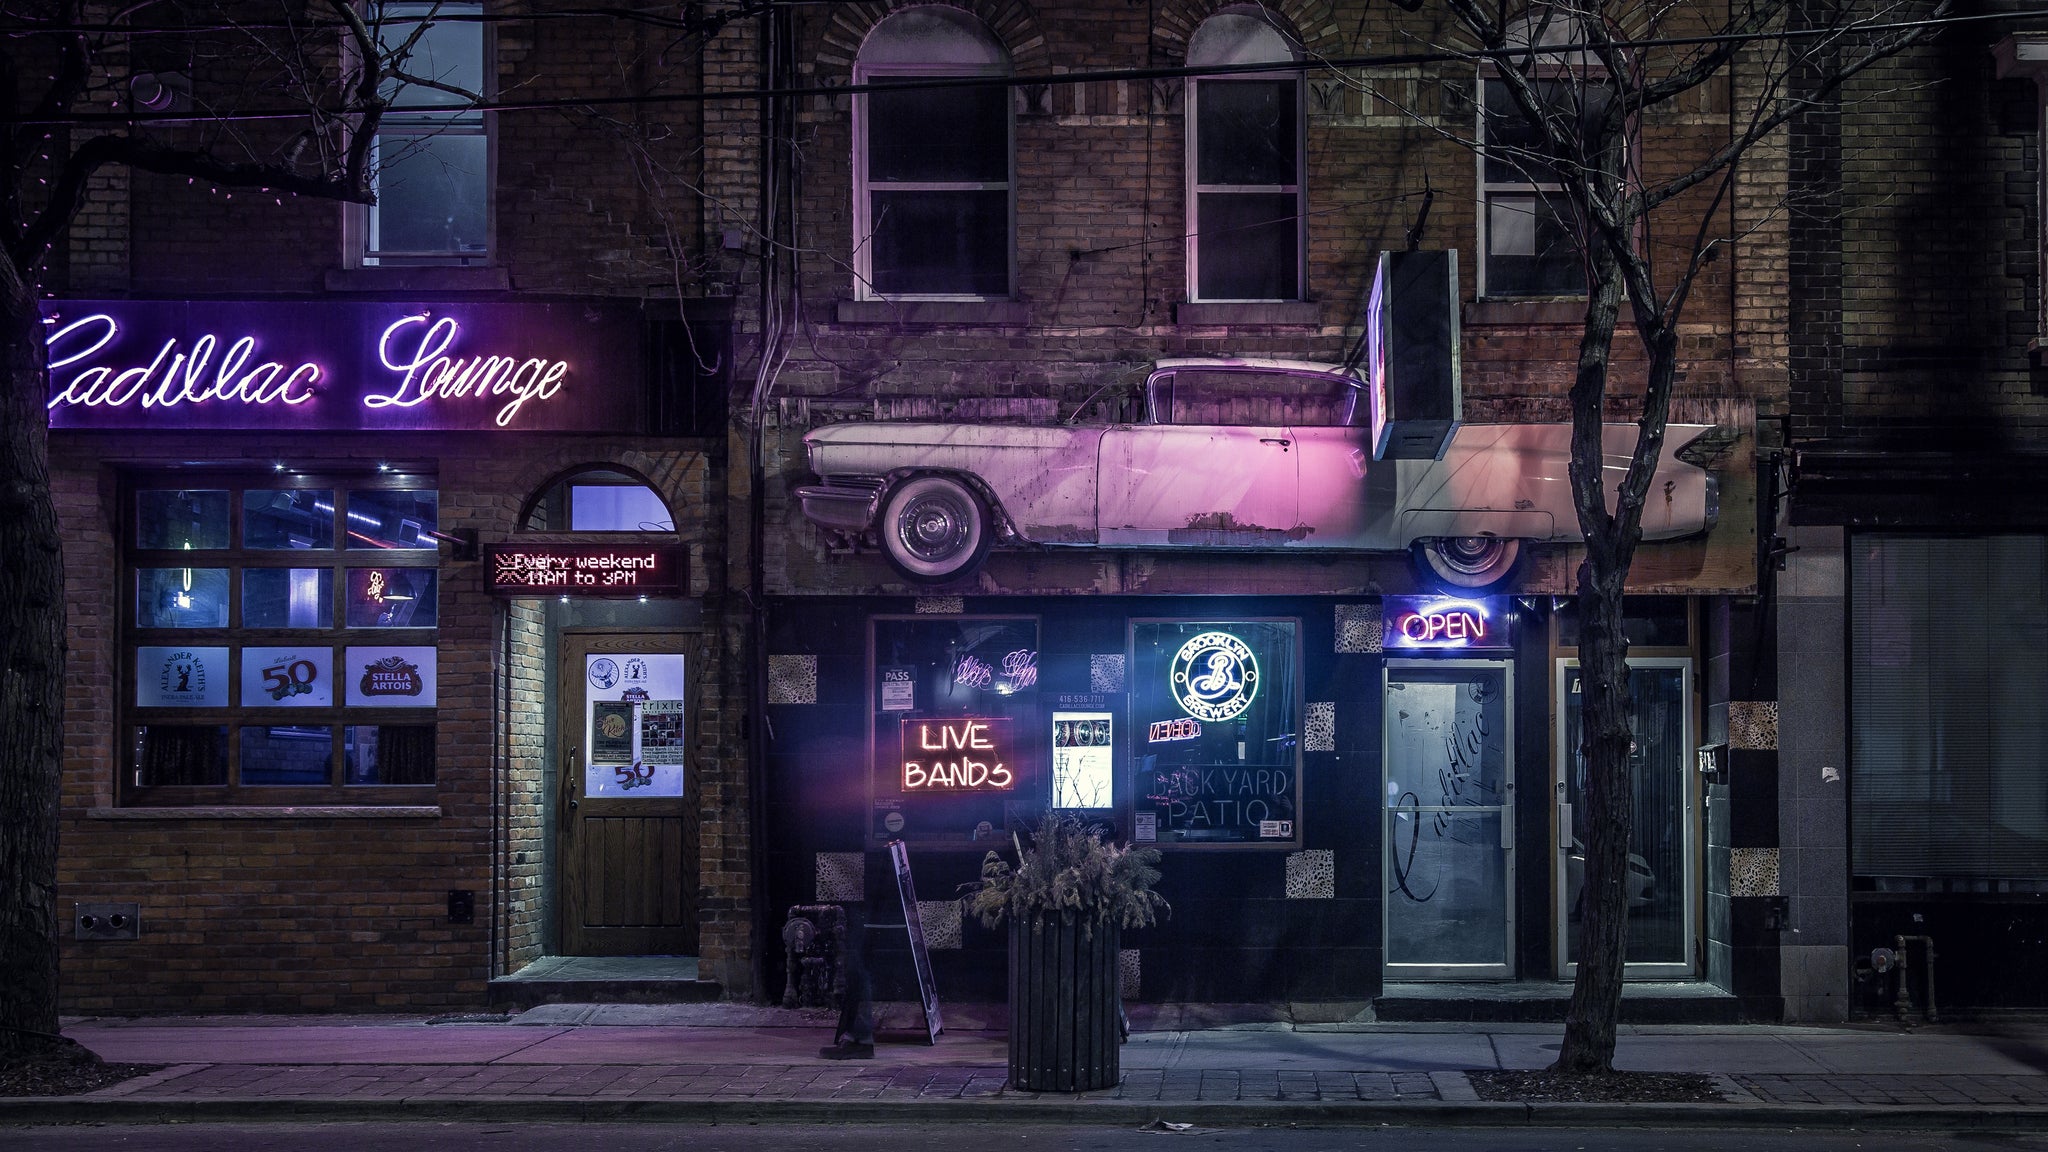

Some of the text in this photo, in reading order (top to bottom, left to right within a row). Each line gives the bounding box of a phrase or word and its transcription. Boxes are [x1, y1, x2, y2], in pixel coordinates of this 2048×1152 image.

[46, 314, 568, 426] Cadillac Lounge
[514, 553, 656, 569] Every weekend
[528, 570, 636, 585] 11AM to 3PM
[1403, 612, 1484, 641] OPEN
[1181, 635, 1249, 661] BROOKLYN
[161, 652, 192, 691] ALEXANDER
[262, 660, 317, 692] 50
[372, 672, 411, 681] STELLA
[885, 672, 910, 681] PASS
[372, 681, 412, 690] ARTOIS
[642, 701, 683, 710] trixie
[1182, 693, 1248, 719] BREWERY
[922, 720, 994, 750] LIVE
[905, 756, 1012, 787] BANDS
[1153, 769, 1287, 796] BACK YARD
[1168, 799, 1270, 827] PATIO
[1389, 711, 1491, 903] Cadillac
